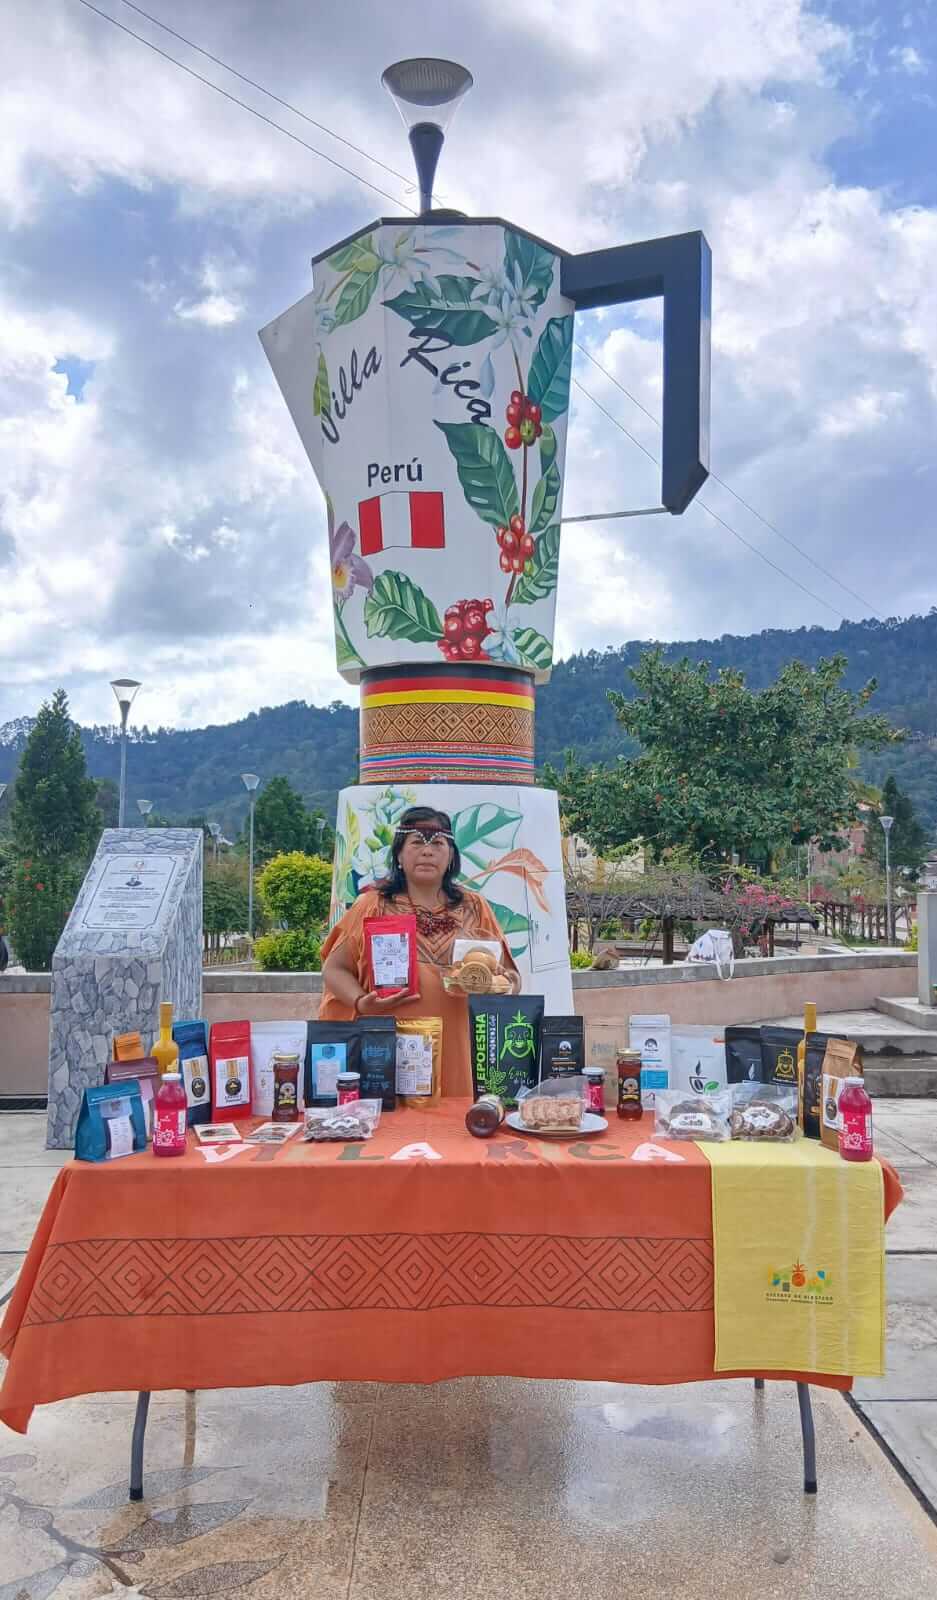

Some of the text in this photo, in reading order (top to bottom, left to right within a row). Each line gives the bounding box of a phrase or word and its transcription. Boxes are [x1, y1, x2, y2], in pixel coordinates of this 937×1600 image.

[320, 328, 491, 443] Villa Rica
[367, 457, 423, 488] Perú
[475, 1013, 486, 1080] EPOESHA
[194, 1140, 686, 1163] VILLA RICA
